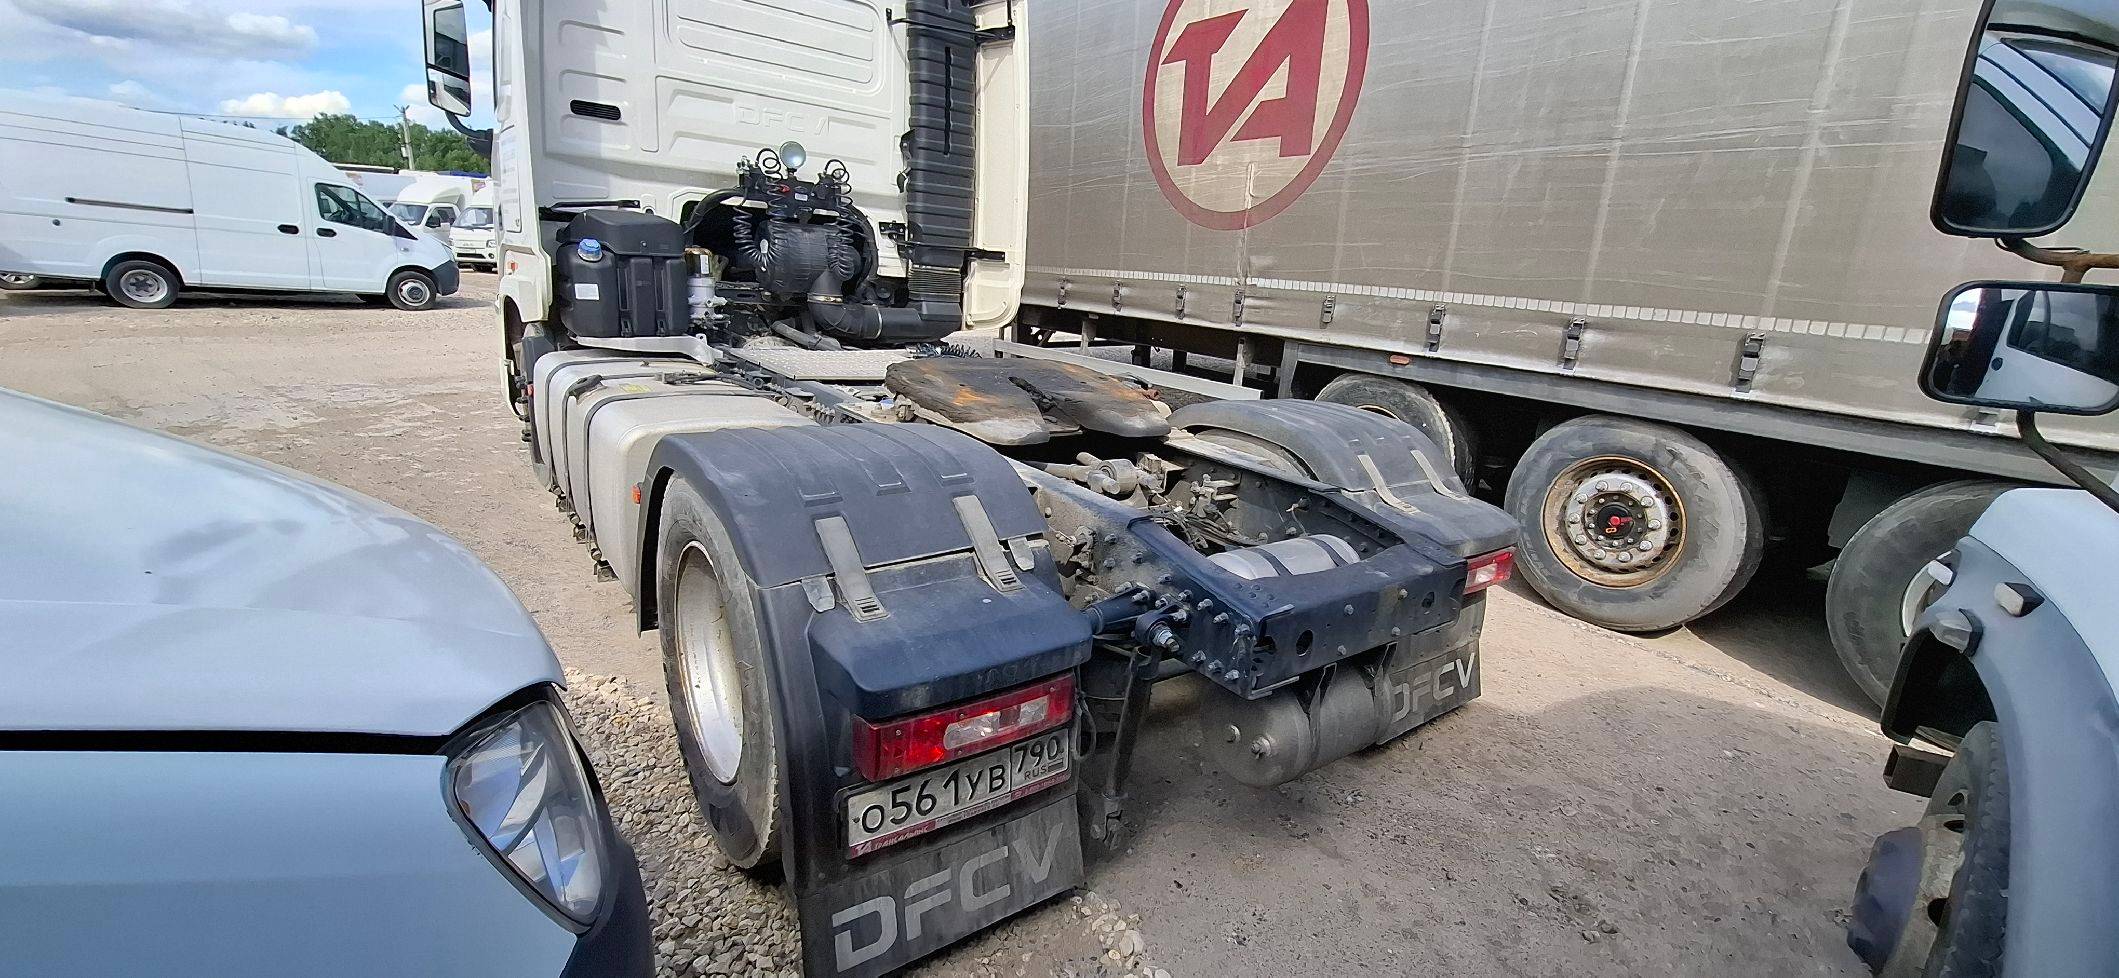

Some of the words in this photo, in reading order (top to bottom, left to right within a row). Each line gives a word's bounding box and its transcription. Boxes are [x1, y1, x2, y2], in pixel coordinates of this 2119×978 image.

[1391, 652, 1475, 723] DFCV
[1014, 736, 1059, 773] 790
[1024, 765, 1048, 780] RUS
[832, 823, 1063, 973] DFCV
